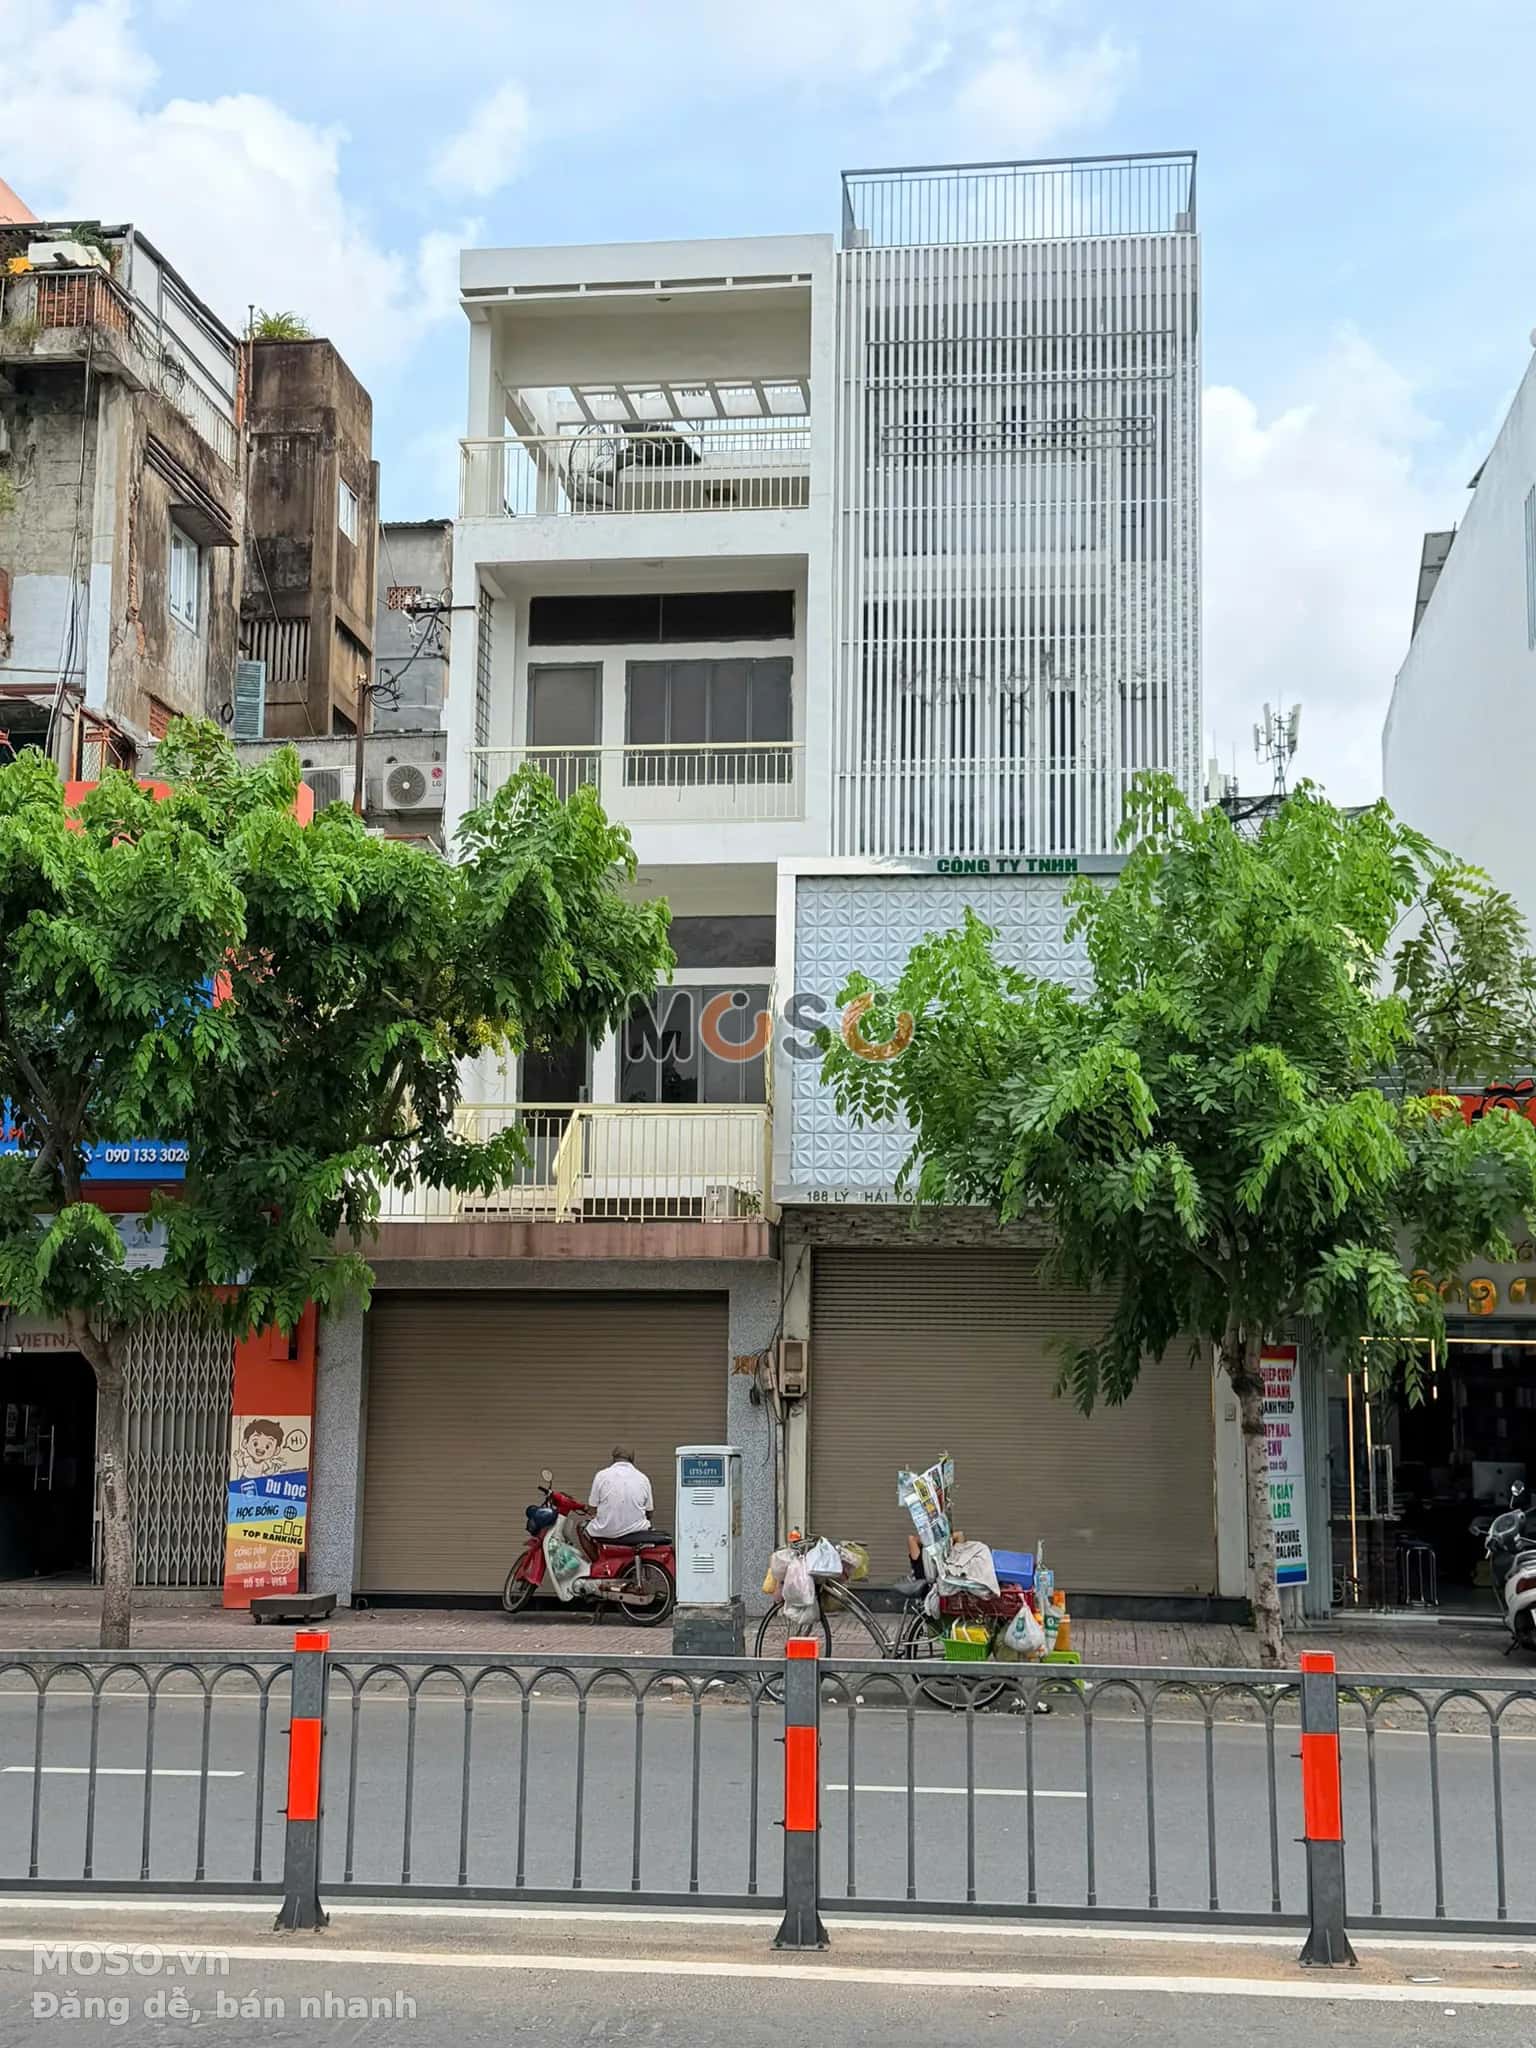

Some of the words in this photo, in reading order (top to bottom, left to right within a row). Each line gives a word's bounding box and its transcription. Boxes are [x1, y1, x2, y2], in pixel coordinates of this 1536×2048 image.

[432, 780, 442, 788] LG
[937, 855, 990, 873] CÔNG
[996, 859, 1021, 873] TY
[1026, 858, 1078, 872] TNHH
[105, 1149, 130, 1163] 090
[133, 1149, 157, 1163] 133
[807, 1191, 829, 1203] 188
[16, 1332, 81, 1349] VIETNA
[265, 1478, 281, 1494] Du
[283, 1479, 307, 1499] học
[235, 1506, 254, 1520] HỌC
[242, 1529, 261, 1540] TOP
[262, 1533, 303, 1545] RANKING
